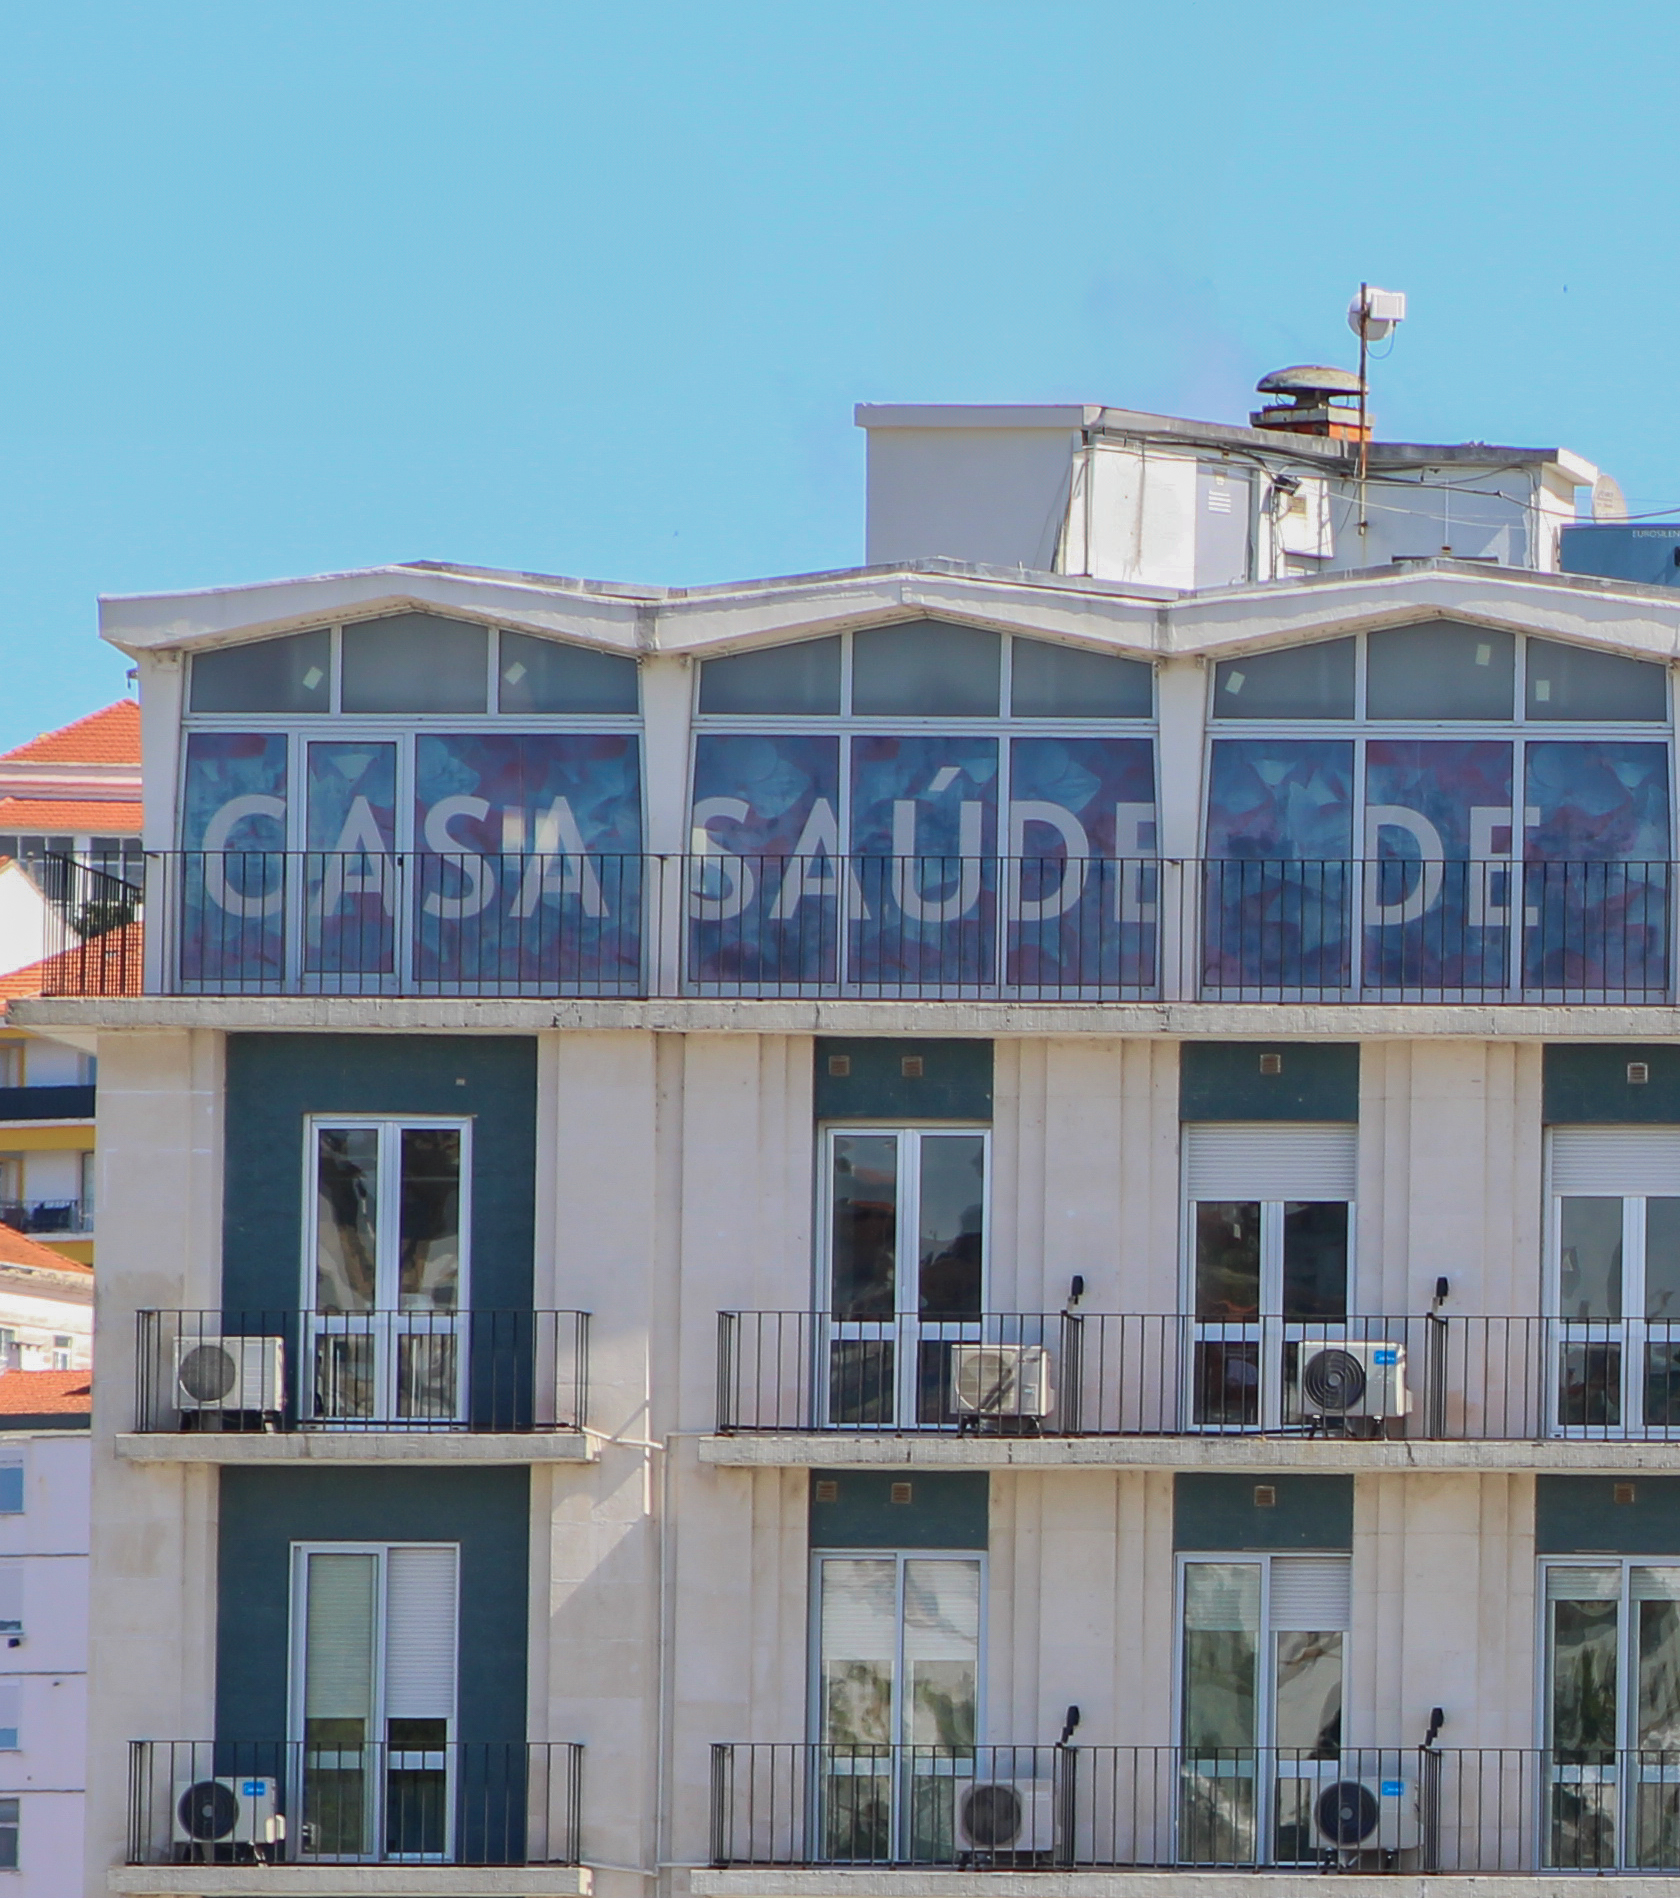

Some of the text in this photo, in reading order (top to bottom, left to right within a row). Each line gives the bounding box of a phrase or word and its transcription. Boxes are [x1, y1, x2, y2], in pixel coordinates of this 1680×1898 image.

[202, 794, 611, 919] CASA
[688, 766, 1156, 923] SAÚDE
[1365, 803, 1540, 928] DE
